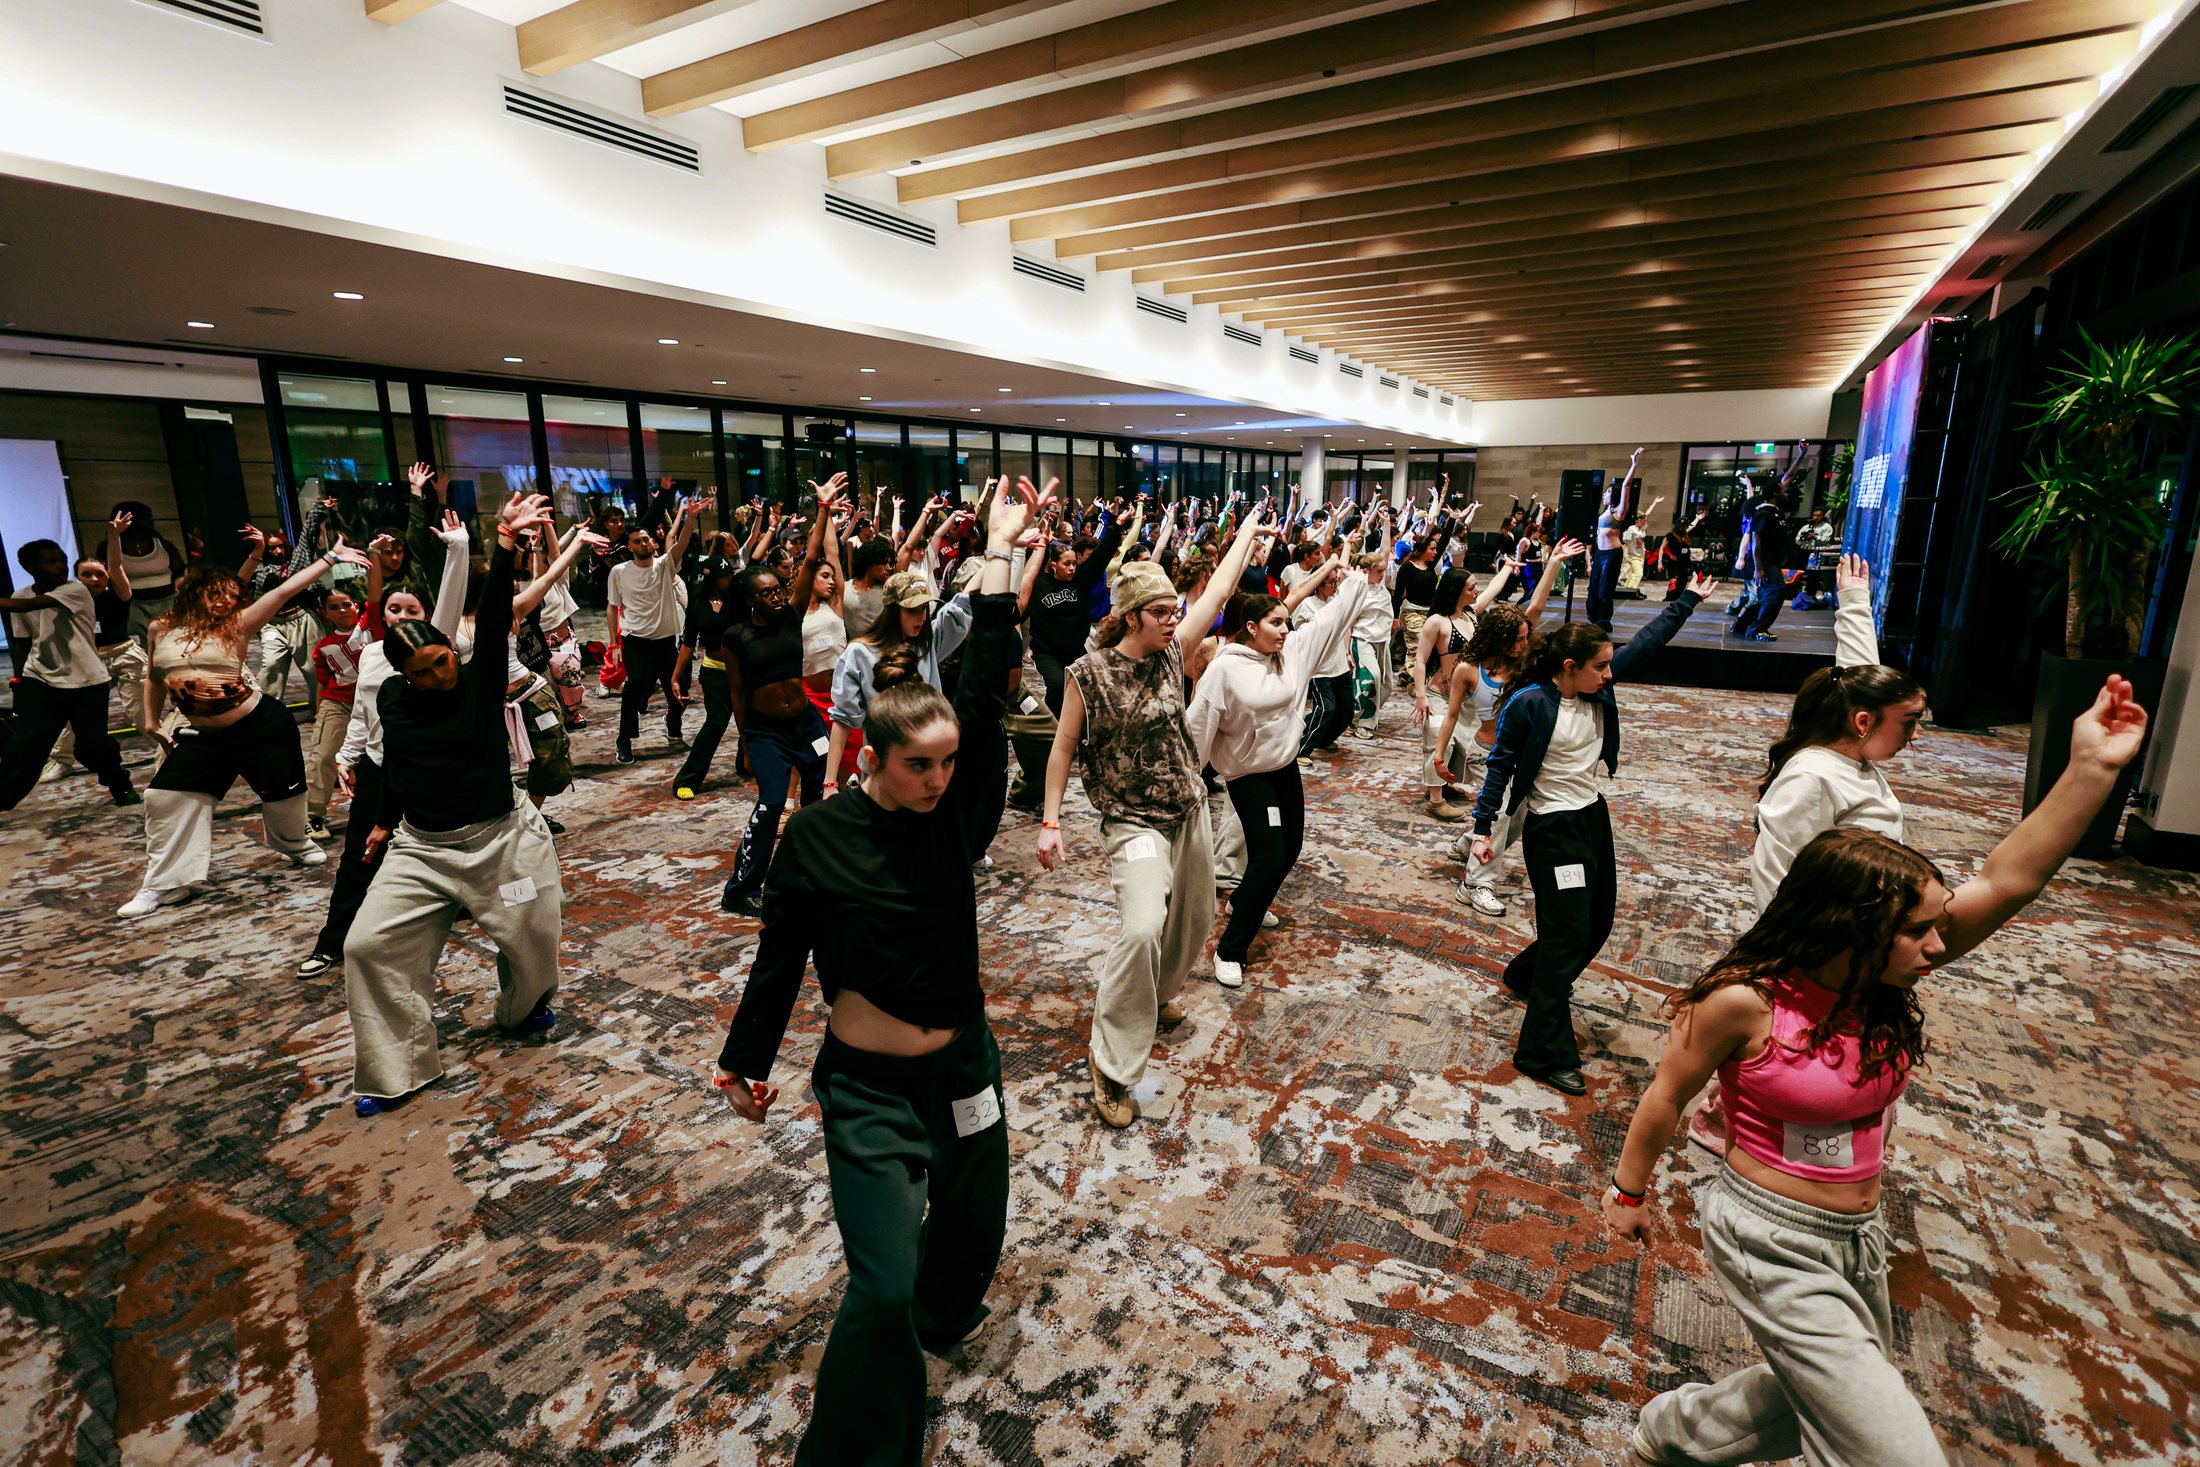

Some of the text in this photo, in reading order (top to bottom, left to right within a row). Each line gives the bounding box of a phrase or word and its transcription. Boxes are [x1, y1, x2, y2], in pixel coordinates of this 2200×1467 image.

[1041, 588, 1078, 608] VISION
[1561, 870, 1582, 883] 84
[965, 1100, 995, 1126] 32
[1804, 1134, 1841, 1156] 88
